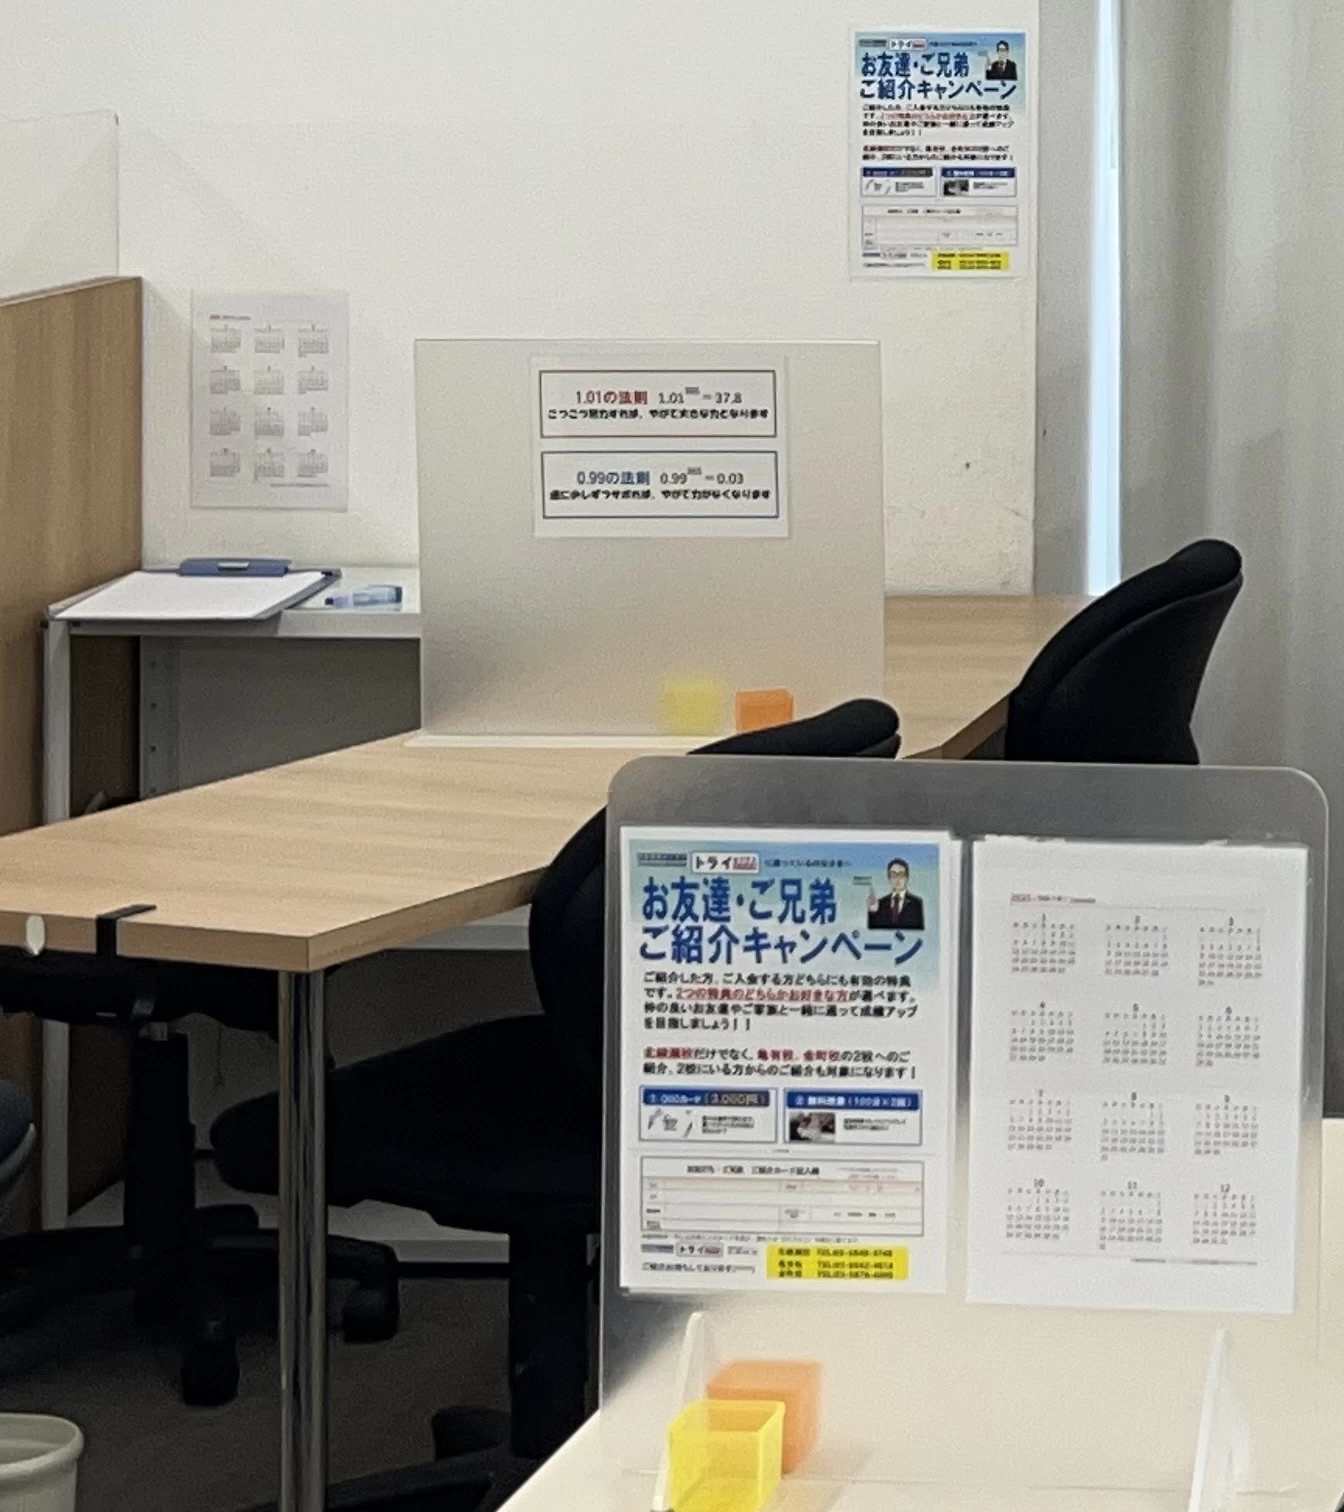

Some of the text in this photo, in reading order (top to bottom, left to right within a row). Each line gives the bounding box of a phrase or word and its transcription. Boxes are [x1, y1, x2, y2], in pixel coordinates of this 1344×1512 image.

[862, 52, 969, 78] お友達・ご兄弟
[860, 79, 1017, 101] ご紹介キャンペーン
[576, 390, 648, 405] 1.01の法則
[577, 471, 650, 486] 0.99の法則
[695, 856, 731, 870] トライ
[642, 877, 838, 924] お友達・ご兄弟
[640, 925, 923, 965] ご紹介キャンペーン
